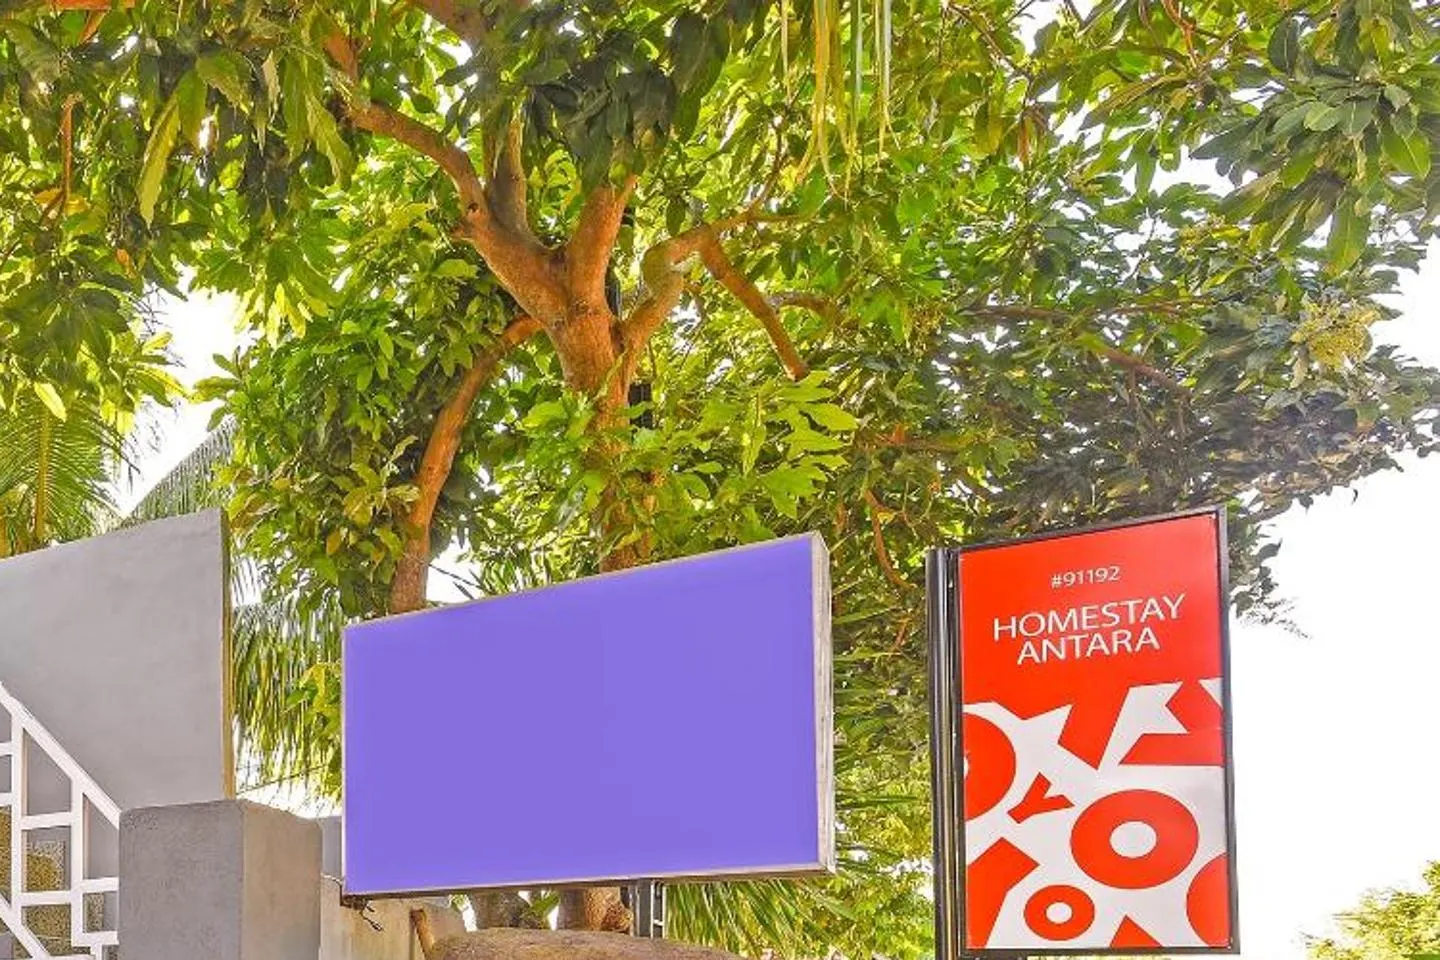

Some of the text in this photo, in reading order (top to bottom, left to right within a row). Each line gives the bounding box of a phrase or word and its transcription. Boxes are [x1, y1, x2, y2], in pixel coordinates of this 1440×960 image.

[1051, 565, 1121, 589] #91192
[993, 592, 1187, 642] HOMESTAY
[1016, 626, 1161, 666] ANTARA
